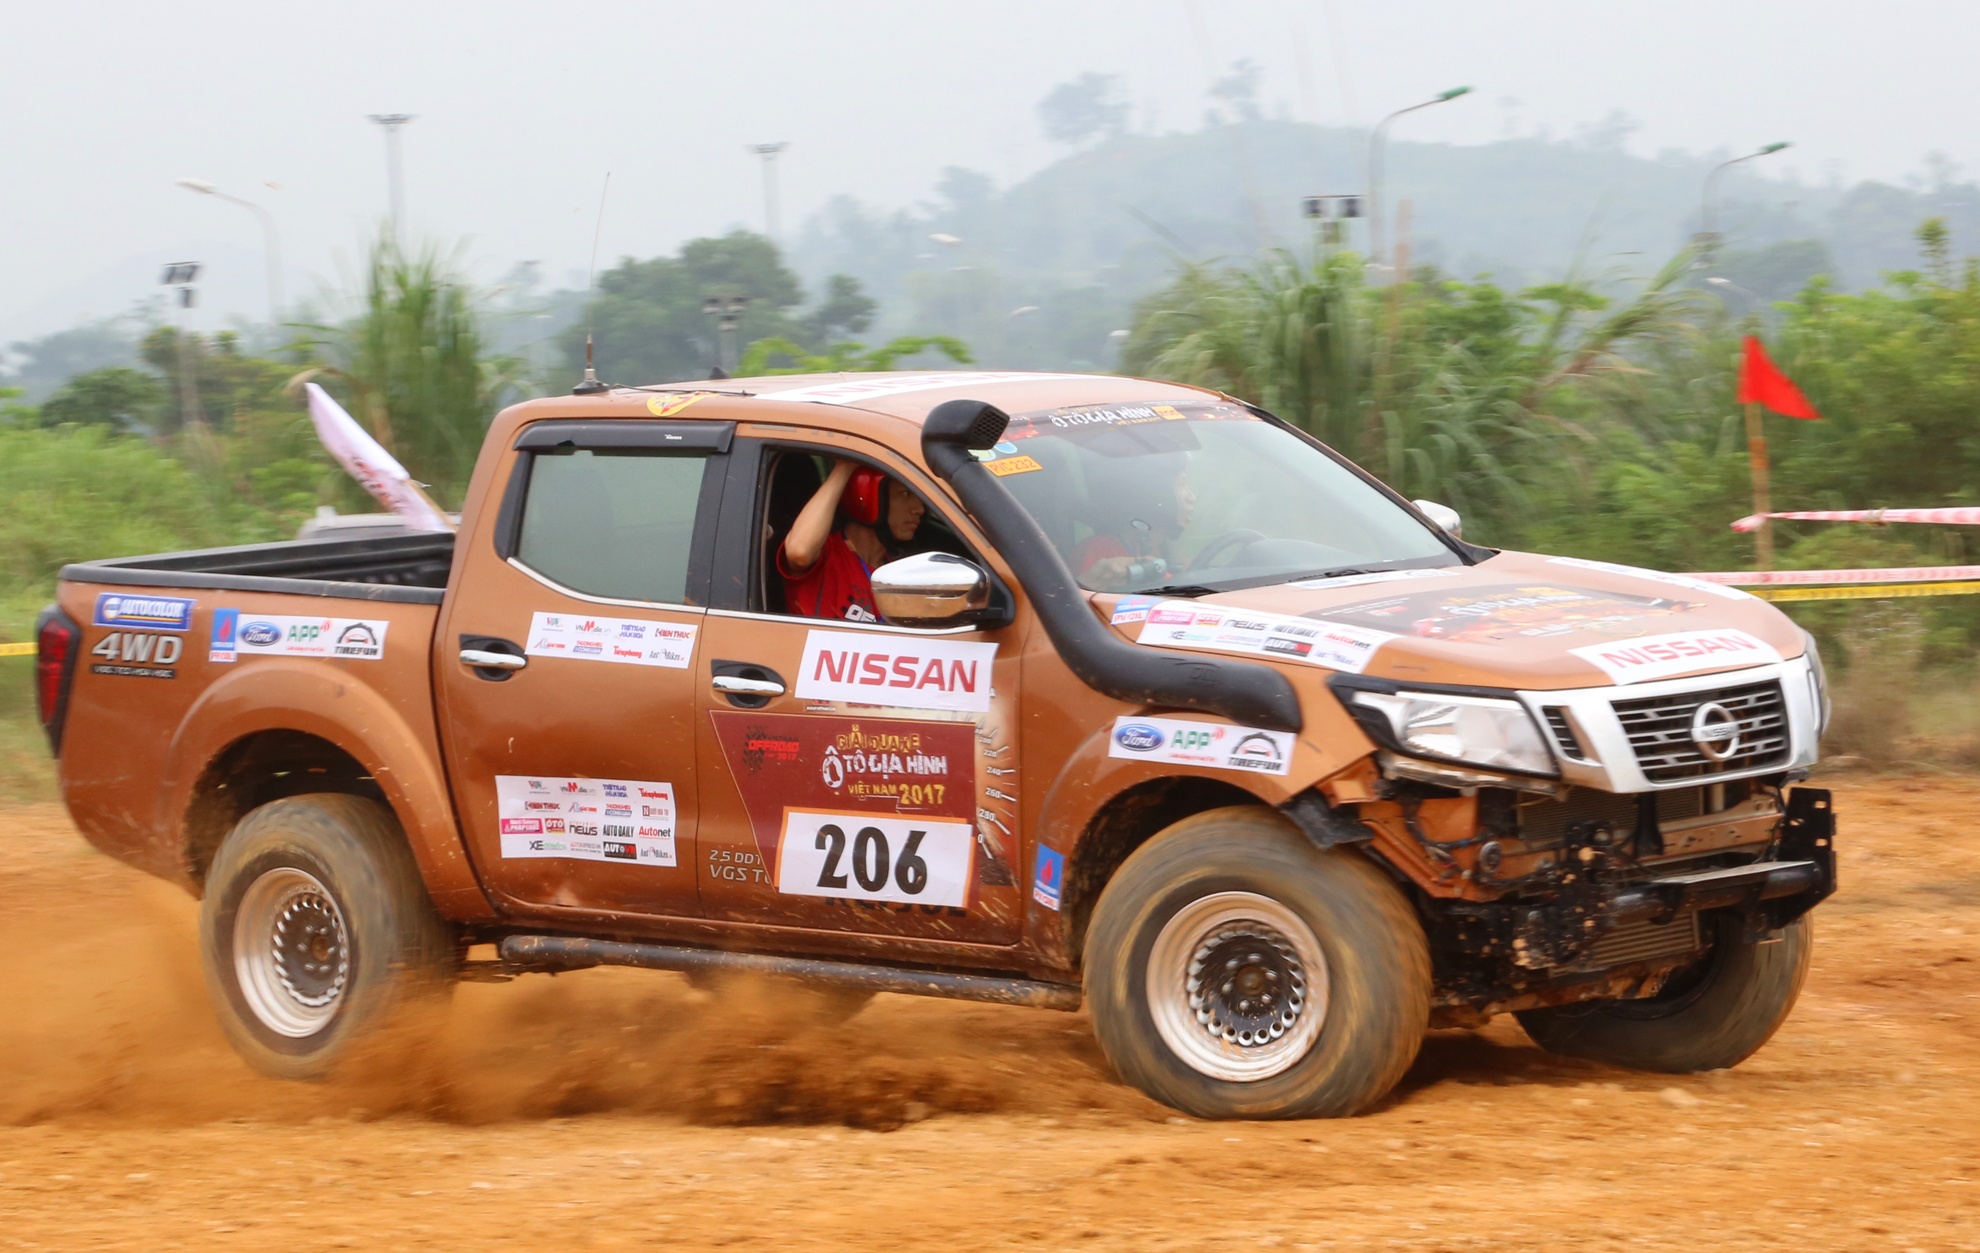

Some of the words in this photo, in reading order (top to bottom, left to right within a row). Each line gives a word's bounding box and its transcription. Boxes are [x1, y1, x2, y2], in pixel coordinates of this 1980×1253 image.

[1009, 458, 1038, 471] 232
[119, 599, 187, 618] AUTOCOLOR
[1114, 614, 1127, 622] PV
[243, 624, 275, 643] Ford
[287, 624, 320, 643] APP
[91, 631, 183, 665] 4WD
[1600, 634, 1759, 668] NISSAN
[813, 649, 977, 693] NISSAN
[748, 739, 800, 753] OFFROAD
[1121, 726, 1158, 749] Ford
[1170, 729, 1212, 751] APP
[983, 748, 999, 758] 220
[822, 744, 845, 789] Ô
[842, 749, 867, 773] TÔ
[905, 749, 948, 775] HÌNH
[986, 766, 1003, 777] 240
[847, 780, 871, 799] VIỆT
[872, 783, 899, 796] NAM
[899, 783, 946, 806] 2017
[985, 786, 1002, 799] 260
[979, 807, 996, 822] 280
[603, 824, 618, 837] AUTO
[618, 825, 636, 838] DAILY
[639, 825, 672, 838] Autonet
[814, 822, 929, 896] 206
[709, 864, 748, 883] VGS
